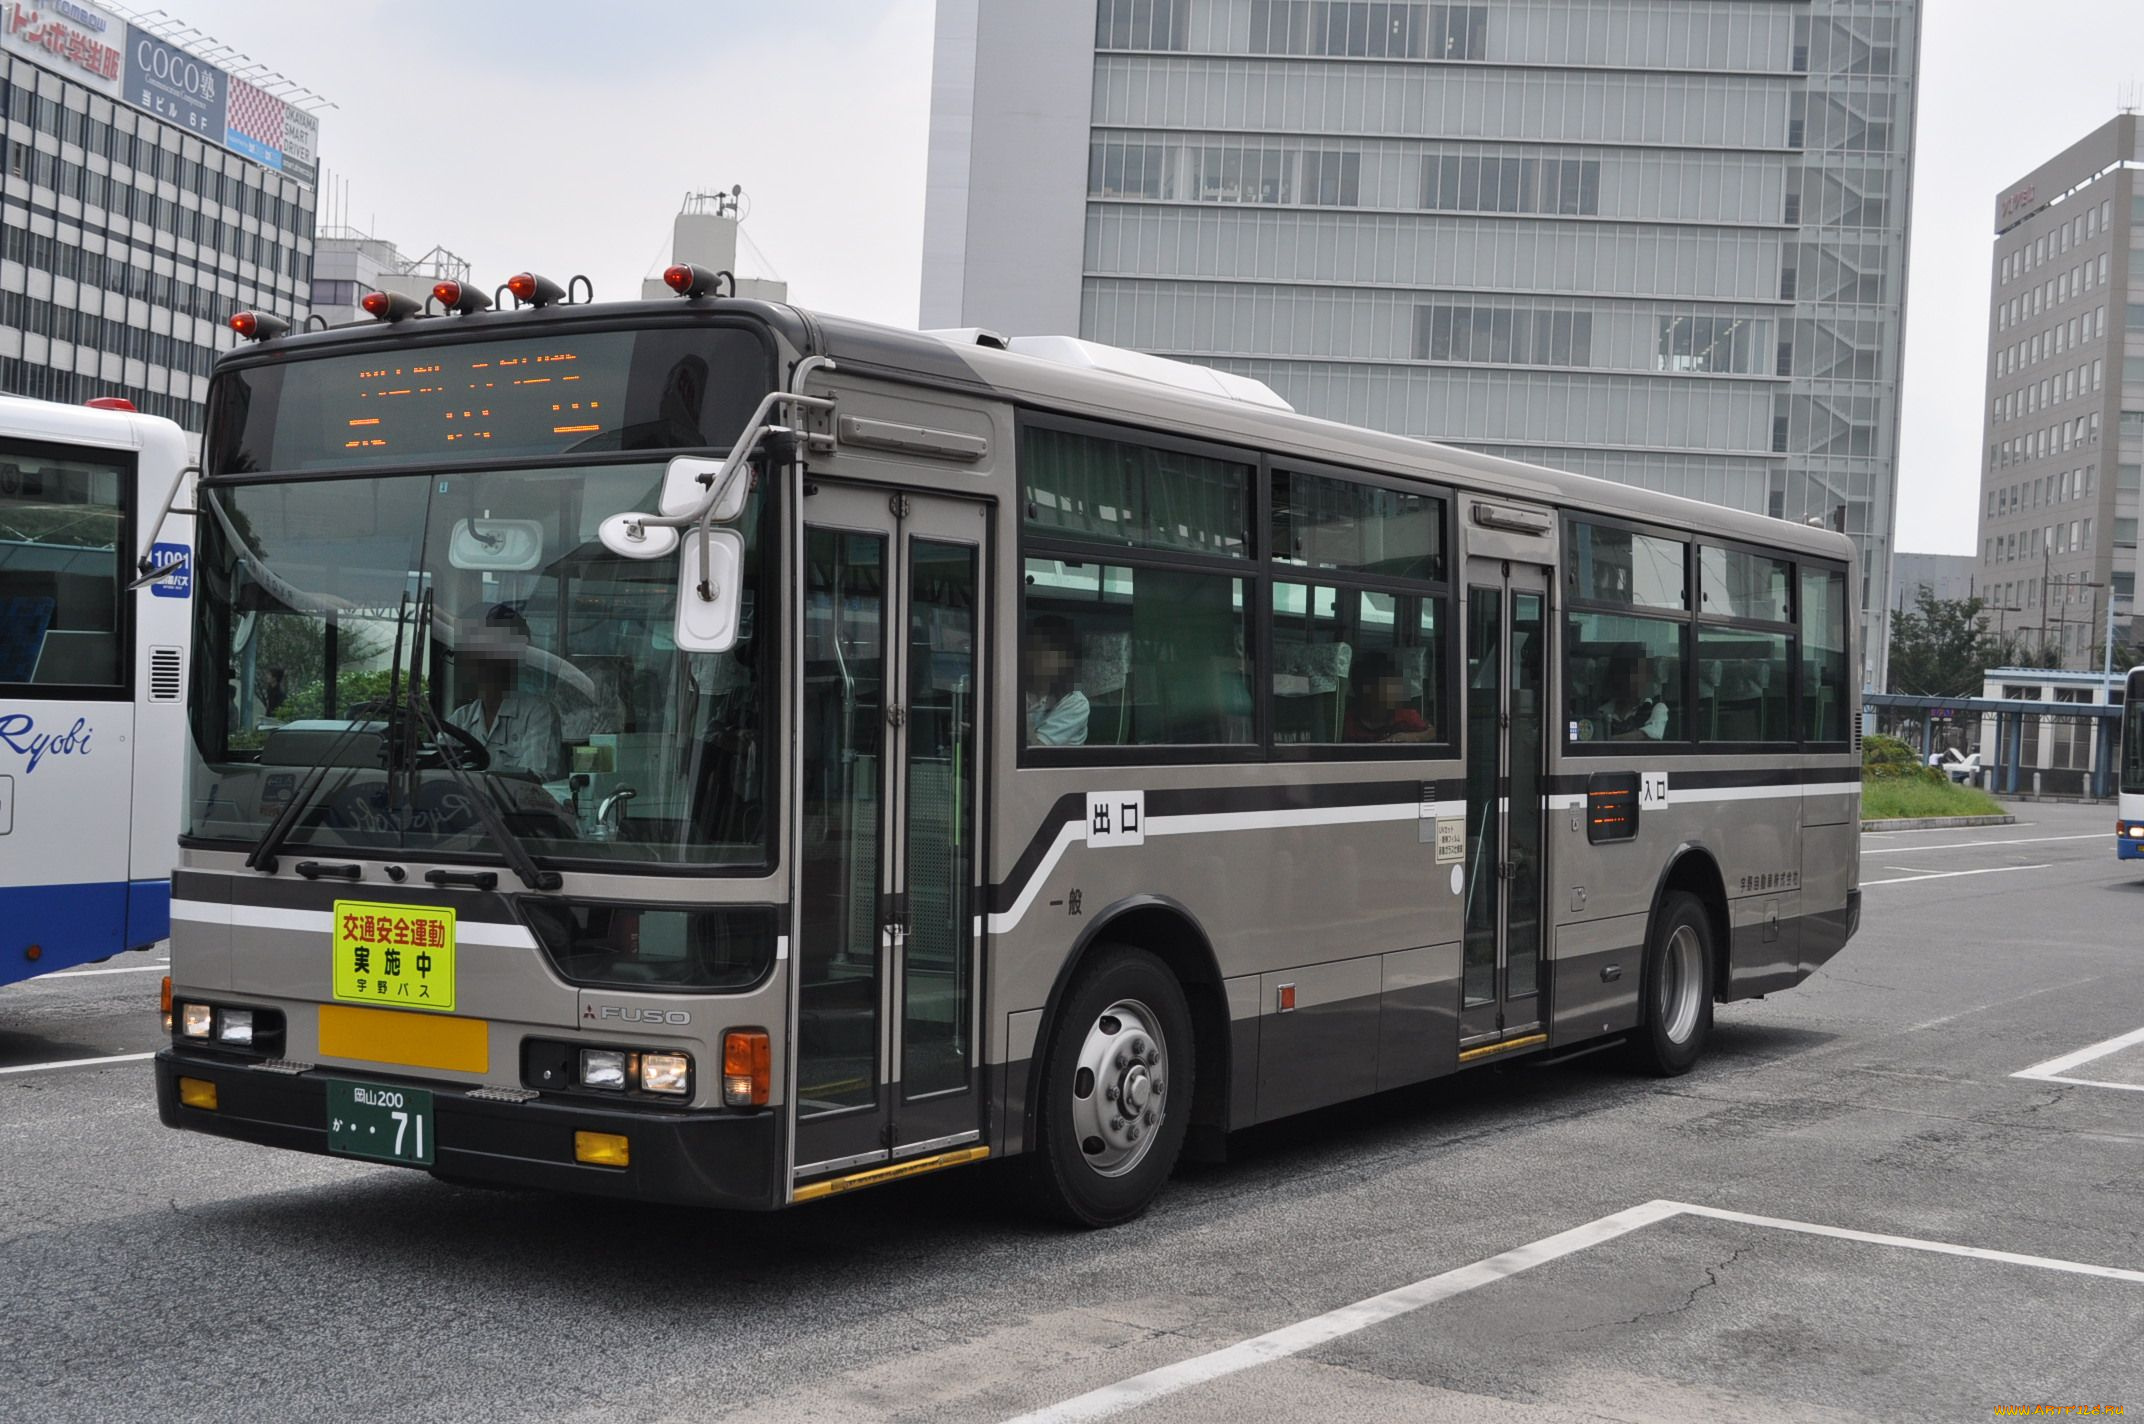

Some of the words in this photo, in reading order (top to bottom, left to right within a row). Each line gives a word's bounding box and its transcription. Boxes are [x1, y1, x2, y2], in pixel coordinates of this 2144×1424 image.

[284, 106, 316, 132] OKAYAMA
[284, 122, 309, 145] SMART
[283, 138, 310, 161] DRIVER
[0, 713, 93, 775] Ryobi
[1644, 780, 1665, 801] 入口
[1093, 803, 1138, 835] 出口
[1049, 888, 1083, 916] 一般
[343, 913, 446, 949] 交通安全運動
[353, 945, 432, 979] 実施中
[356, 978, 431, 998] 宇野バス
[600, 1006, 692, 1025] FUSO
